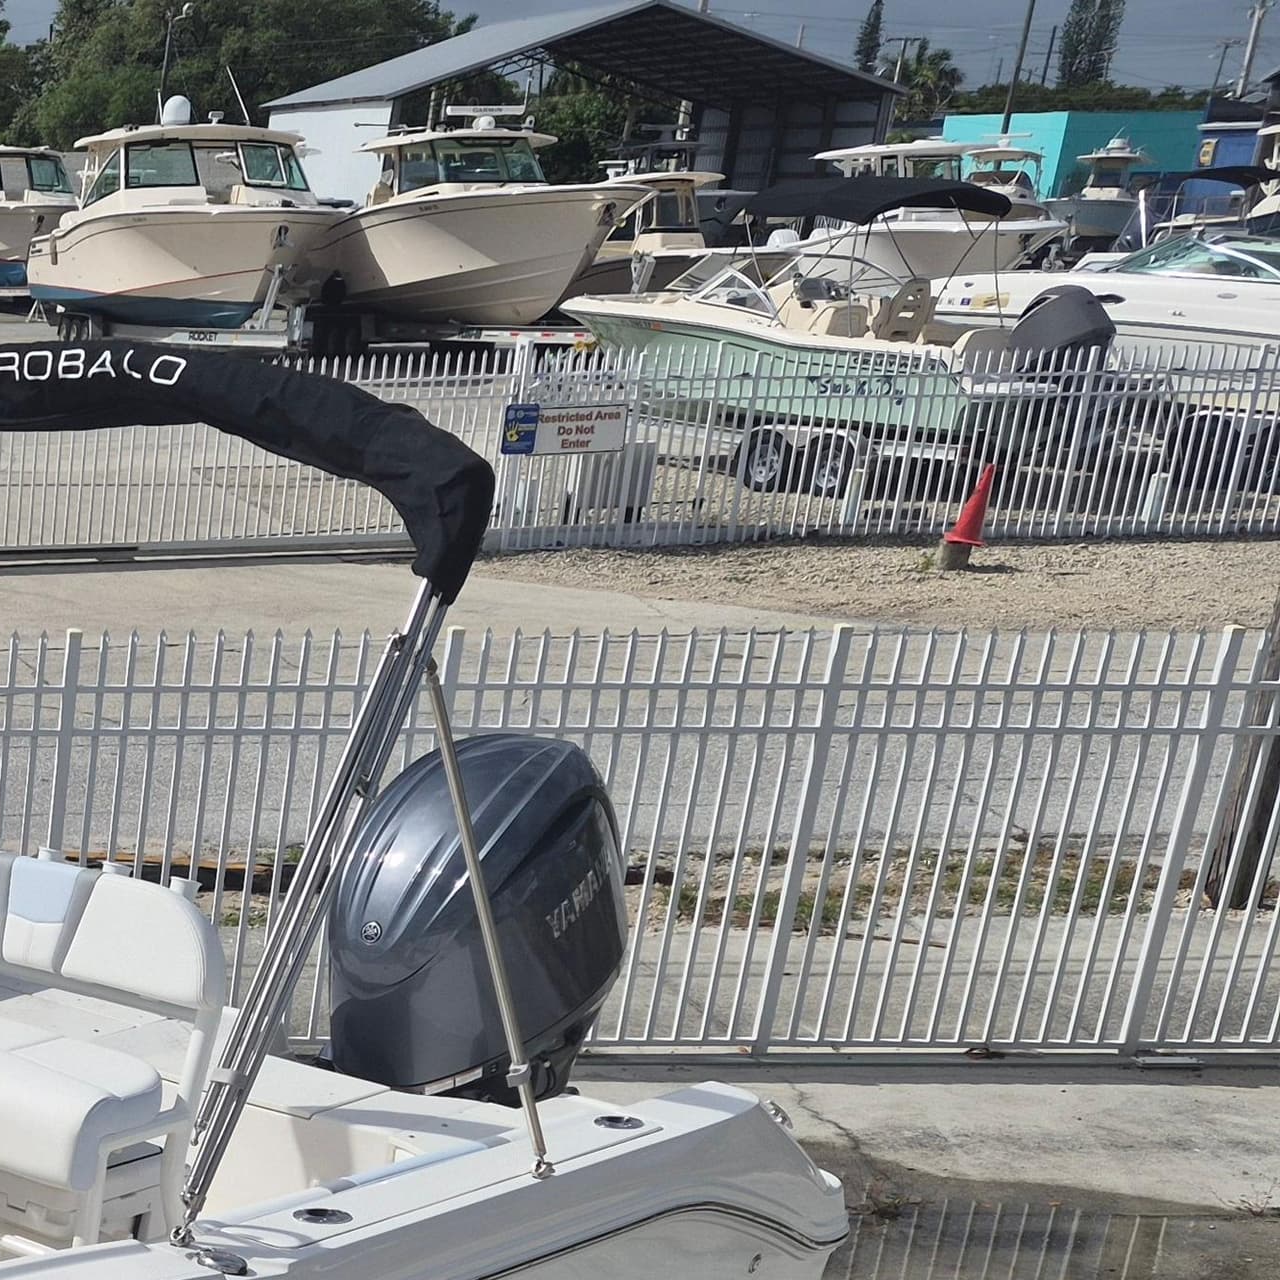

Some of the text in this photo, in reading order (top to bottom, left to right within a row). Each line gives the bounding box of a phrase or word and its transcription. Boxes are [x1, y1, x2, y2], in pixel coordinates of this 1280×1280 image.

[594, 411, 621, 421] Area
[557, 425, 595, 436] Do Not
[560, 439, 592, 449] Enter
